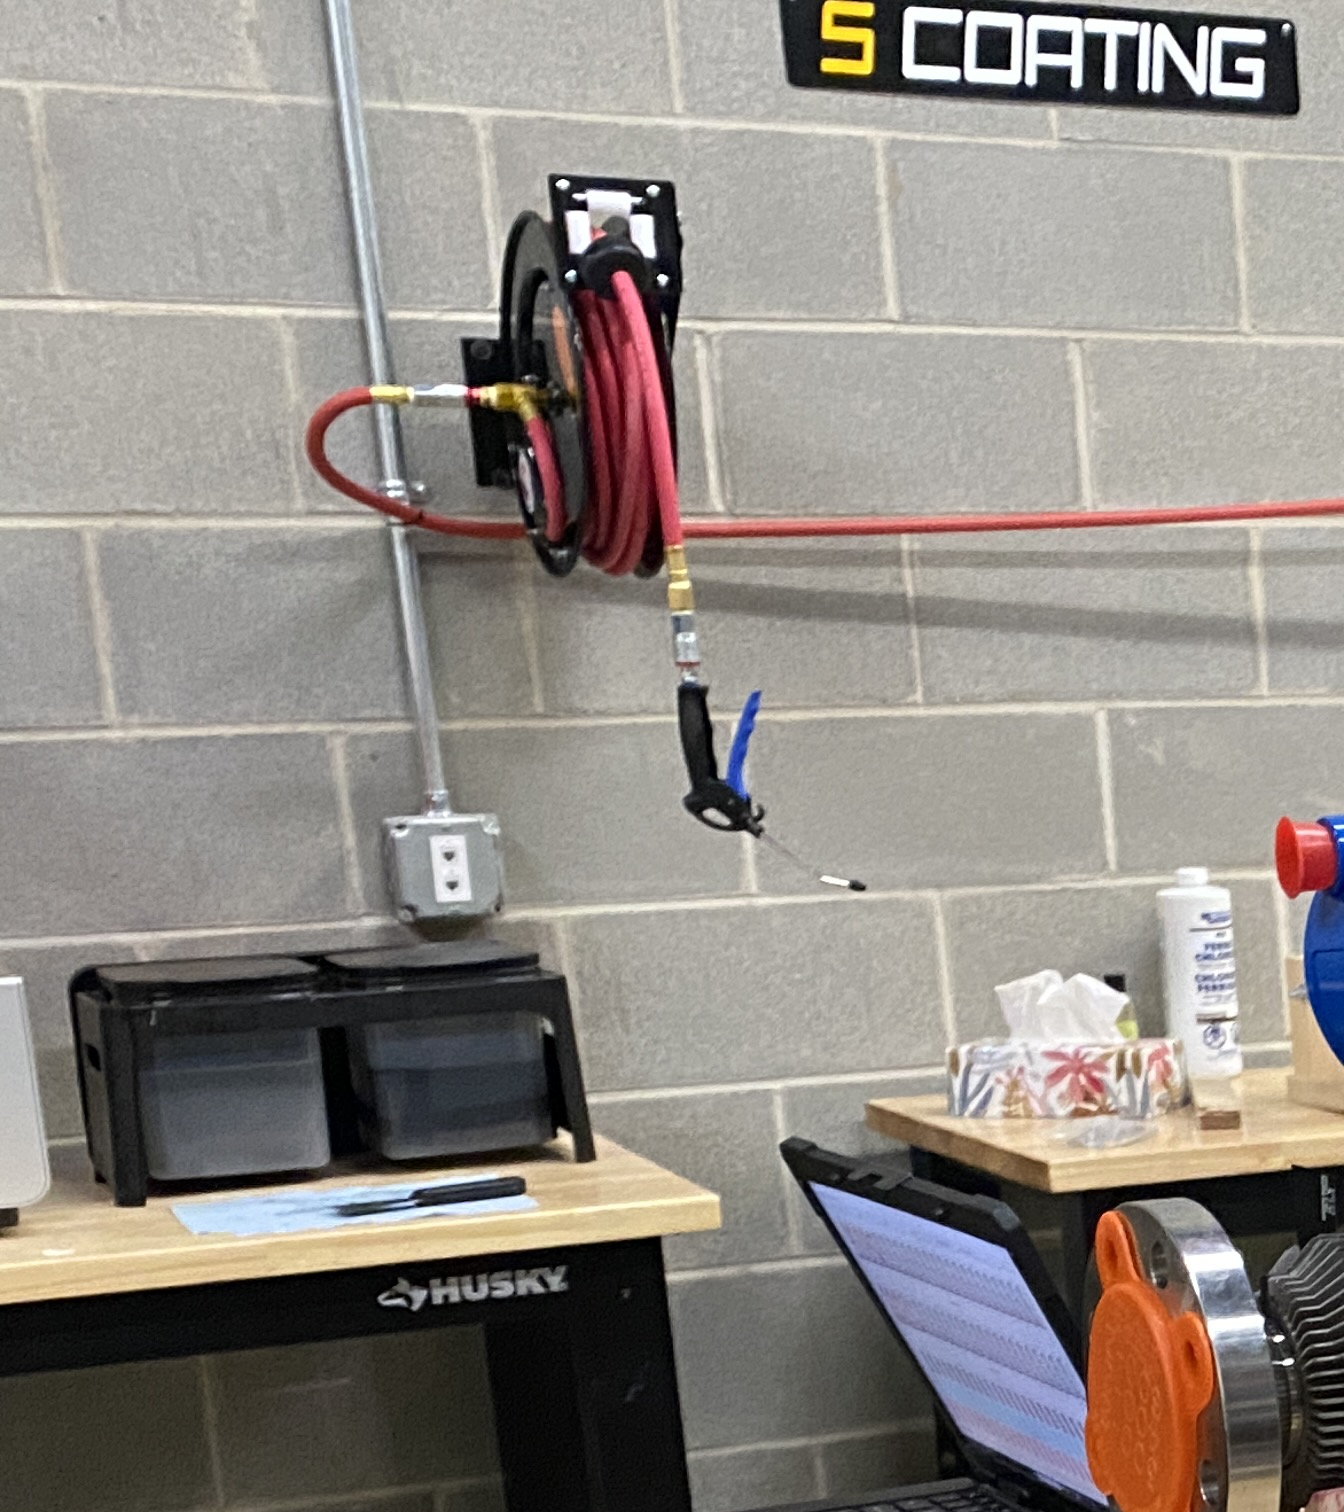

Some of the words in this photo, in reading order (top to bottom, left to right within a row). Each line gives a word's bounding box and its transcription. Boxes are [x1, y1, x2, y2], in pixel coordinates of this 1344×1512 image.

[819, 0, 875, 76] S
[901, 6, 1267, 99] COATING
[428, 1265, 568, 1305] HUSKY
